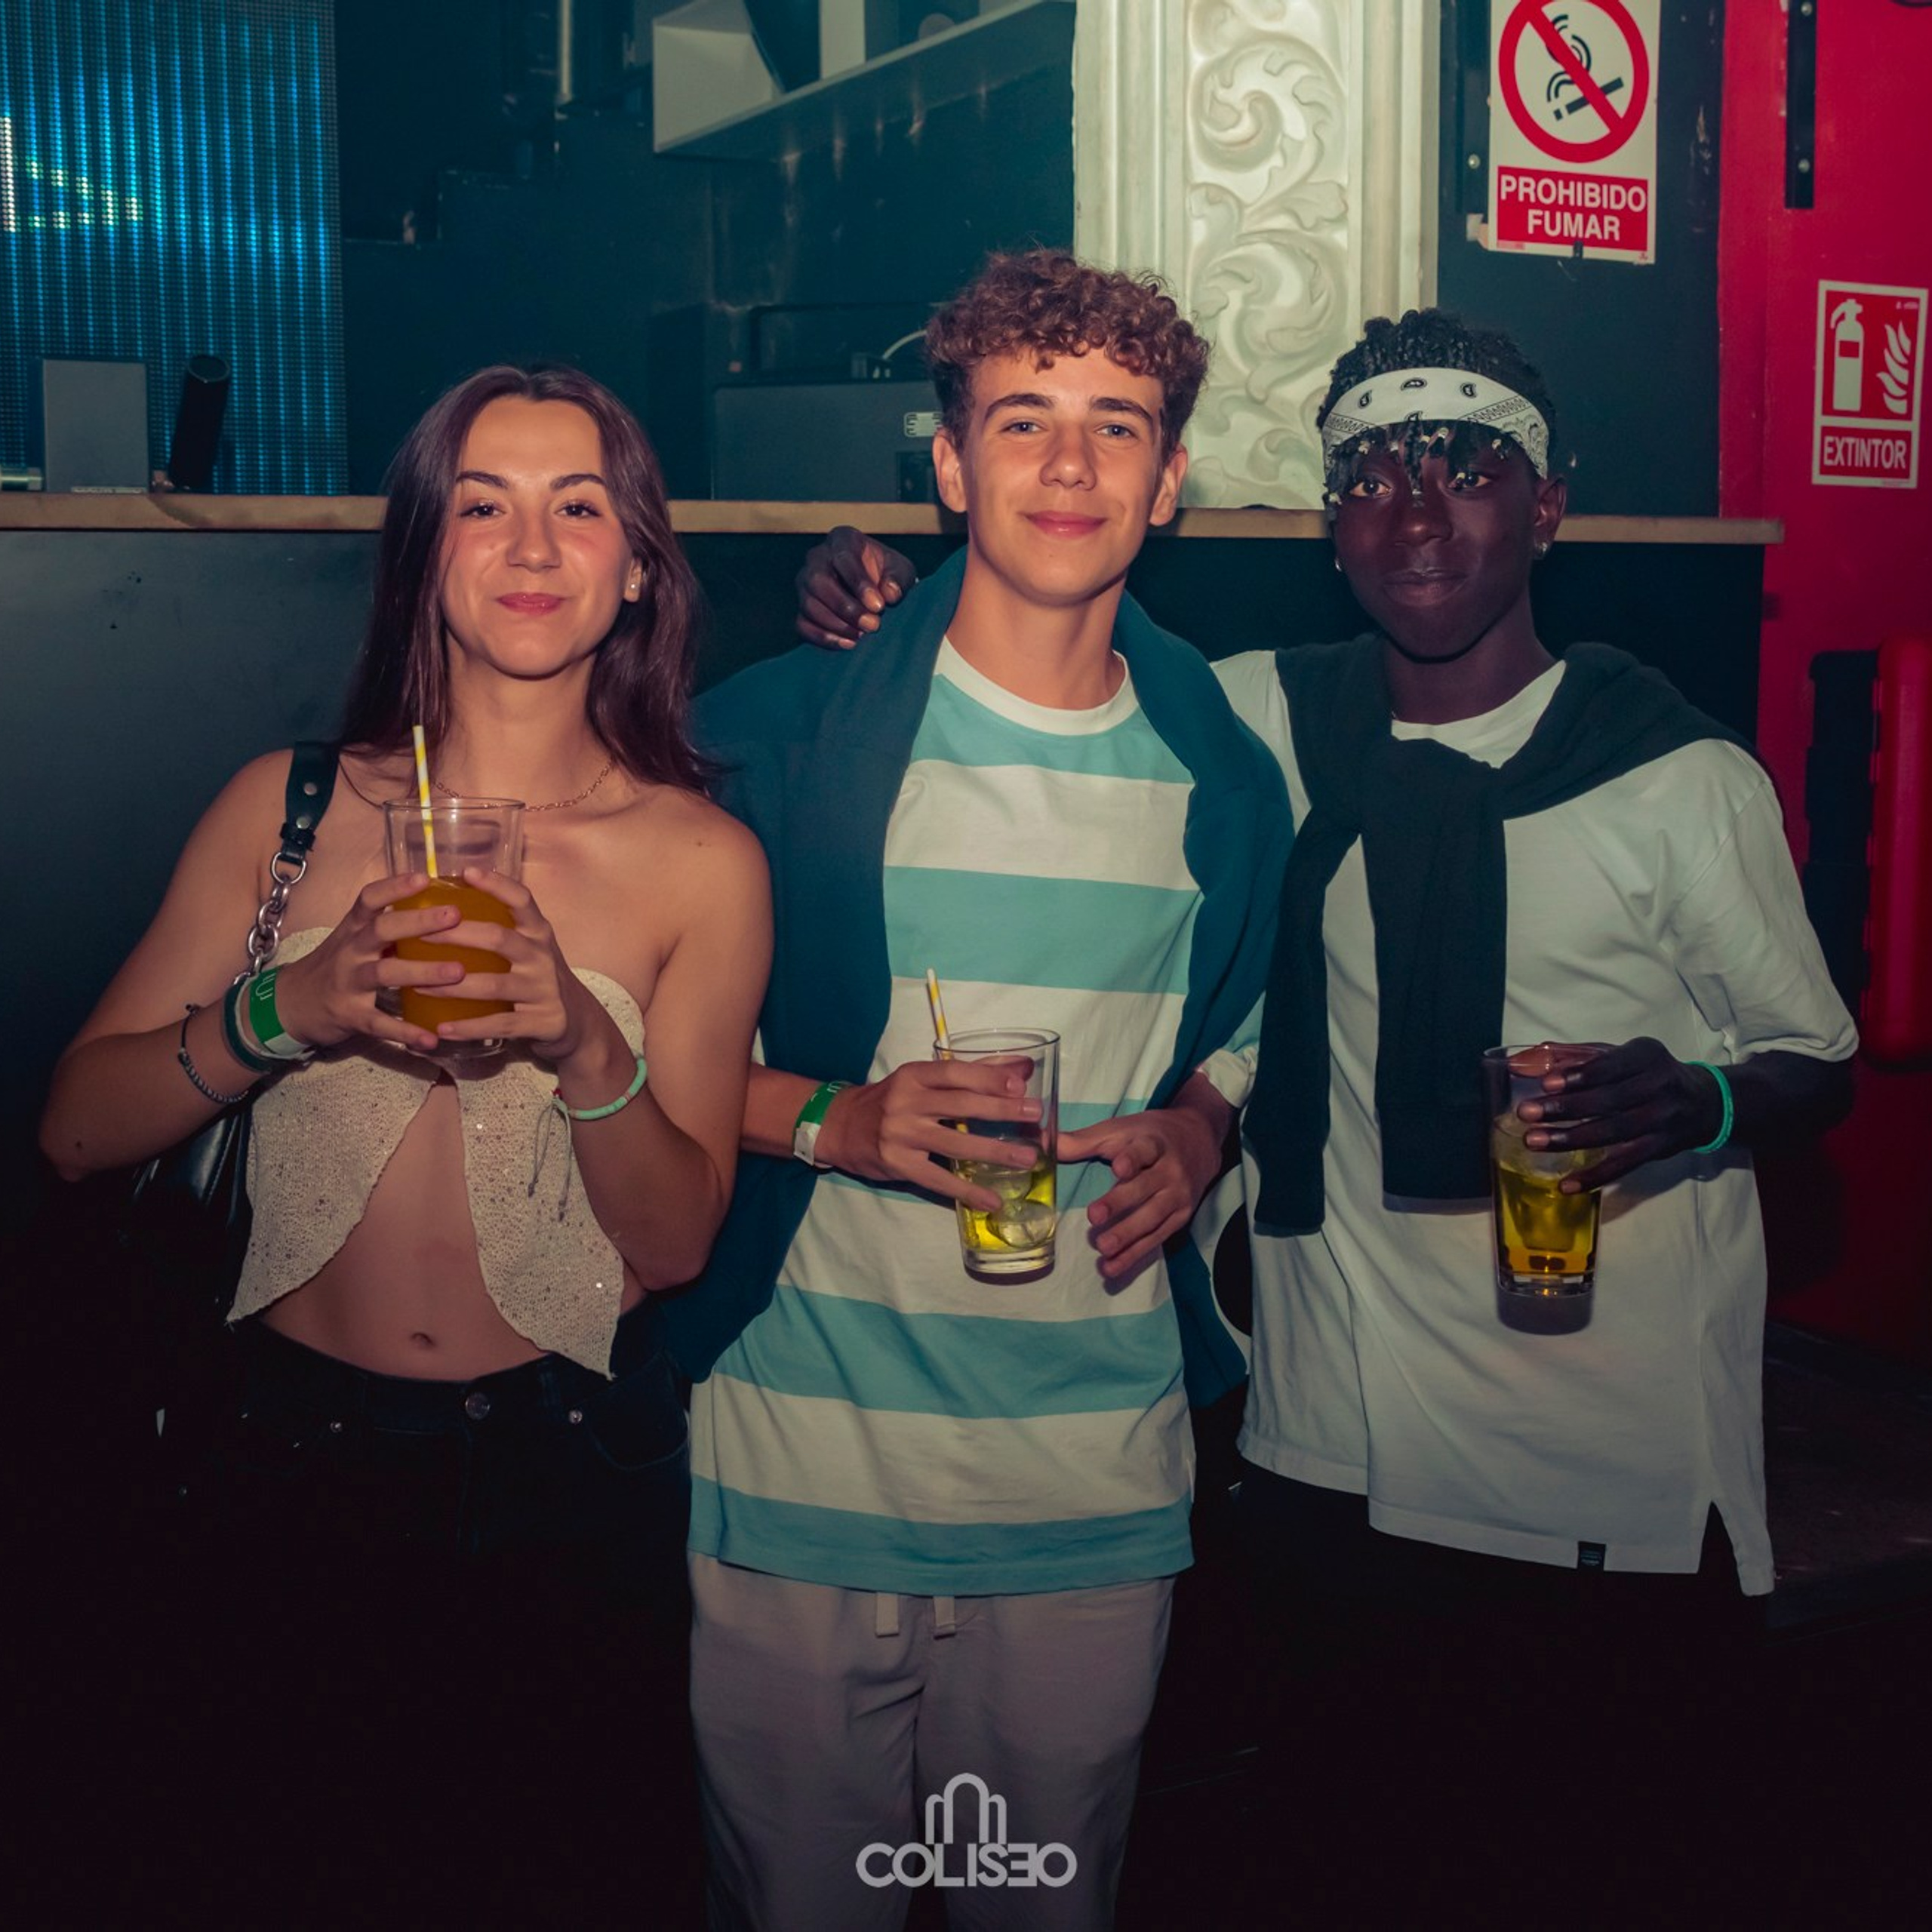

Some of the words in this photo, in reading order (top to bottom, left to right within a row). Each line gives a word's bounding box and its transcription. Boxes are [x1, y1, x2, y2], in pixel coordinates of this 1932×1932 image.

[1500, 174, 1647, 212] PROHIBIDO
[1527, 209, 1620, 241] FUMAR
[1823, 435, 1906, 469] EXTINTOR
